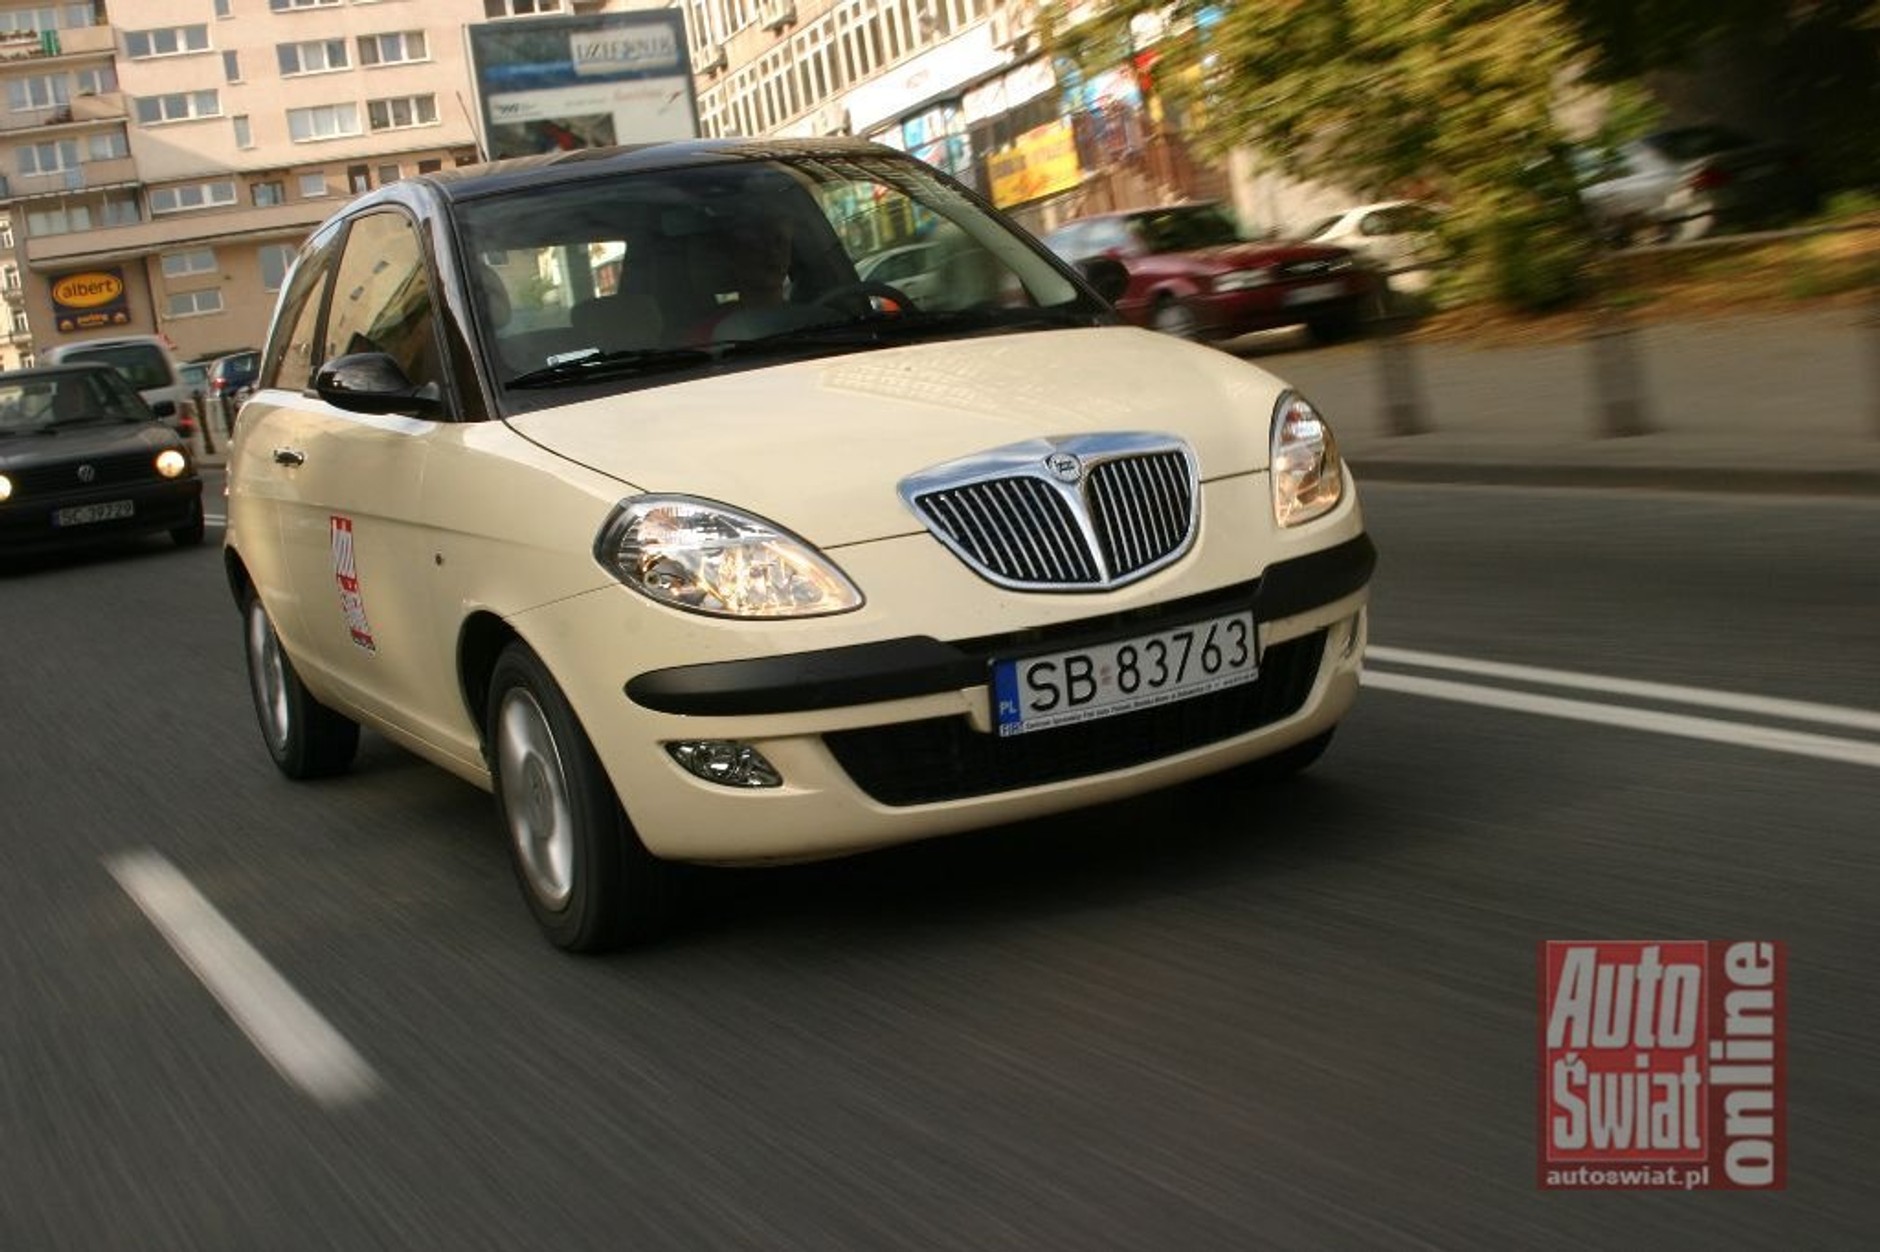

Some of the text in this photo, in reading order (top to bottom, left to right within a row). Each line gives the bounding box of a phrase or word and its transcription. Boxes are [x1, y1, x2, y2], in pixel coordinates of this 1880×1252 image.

[62, 279, 114, 299] albert
[1026, 618, 1249, 712] SB 83763
[999, 700, 1016, 715] PL
